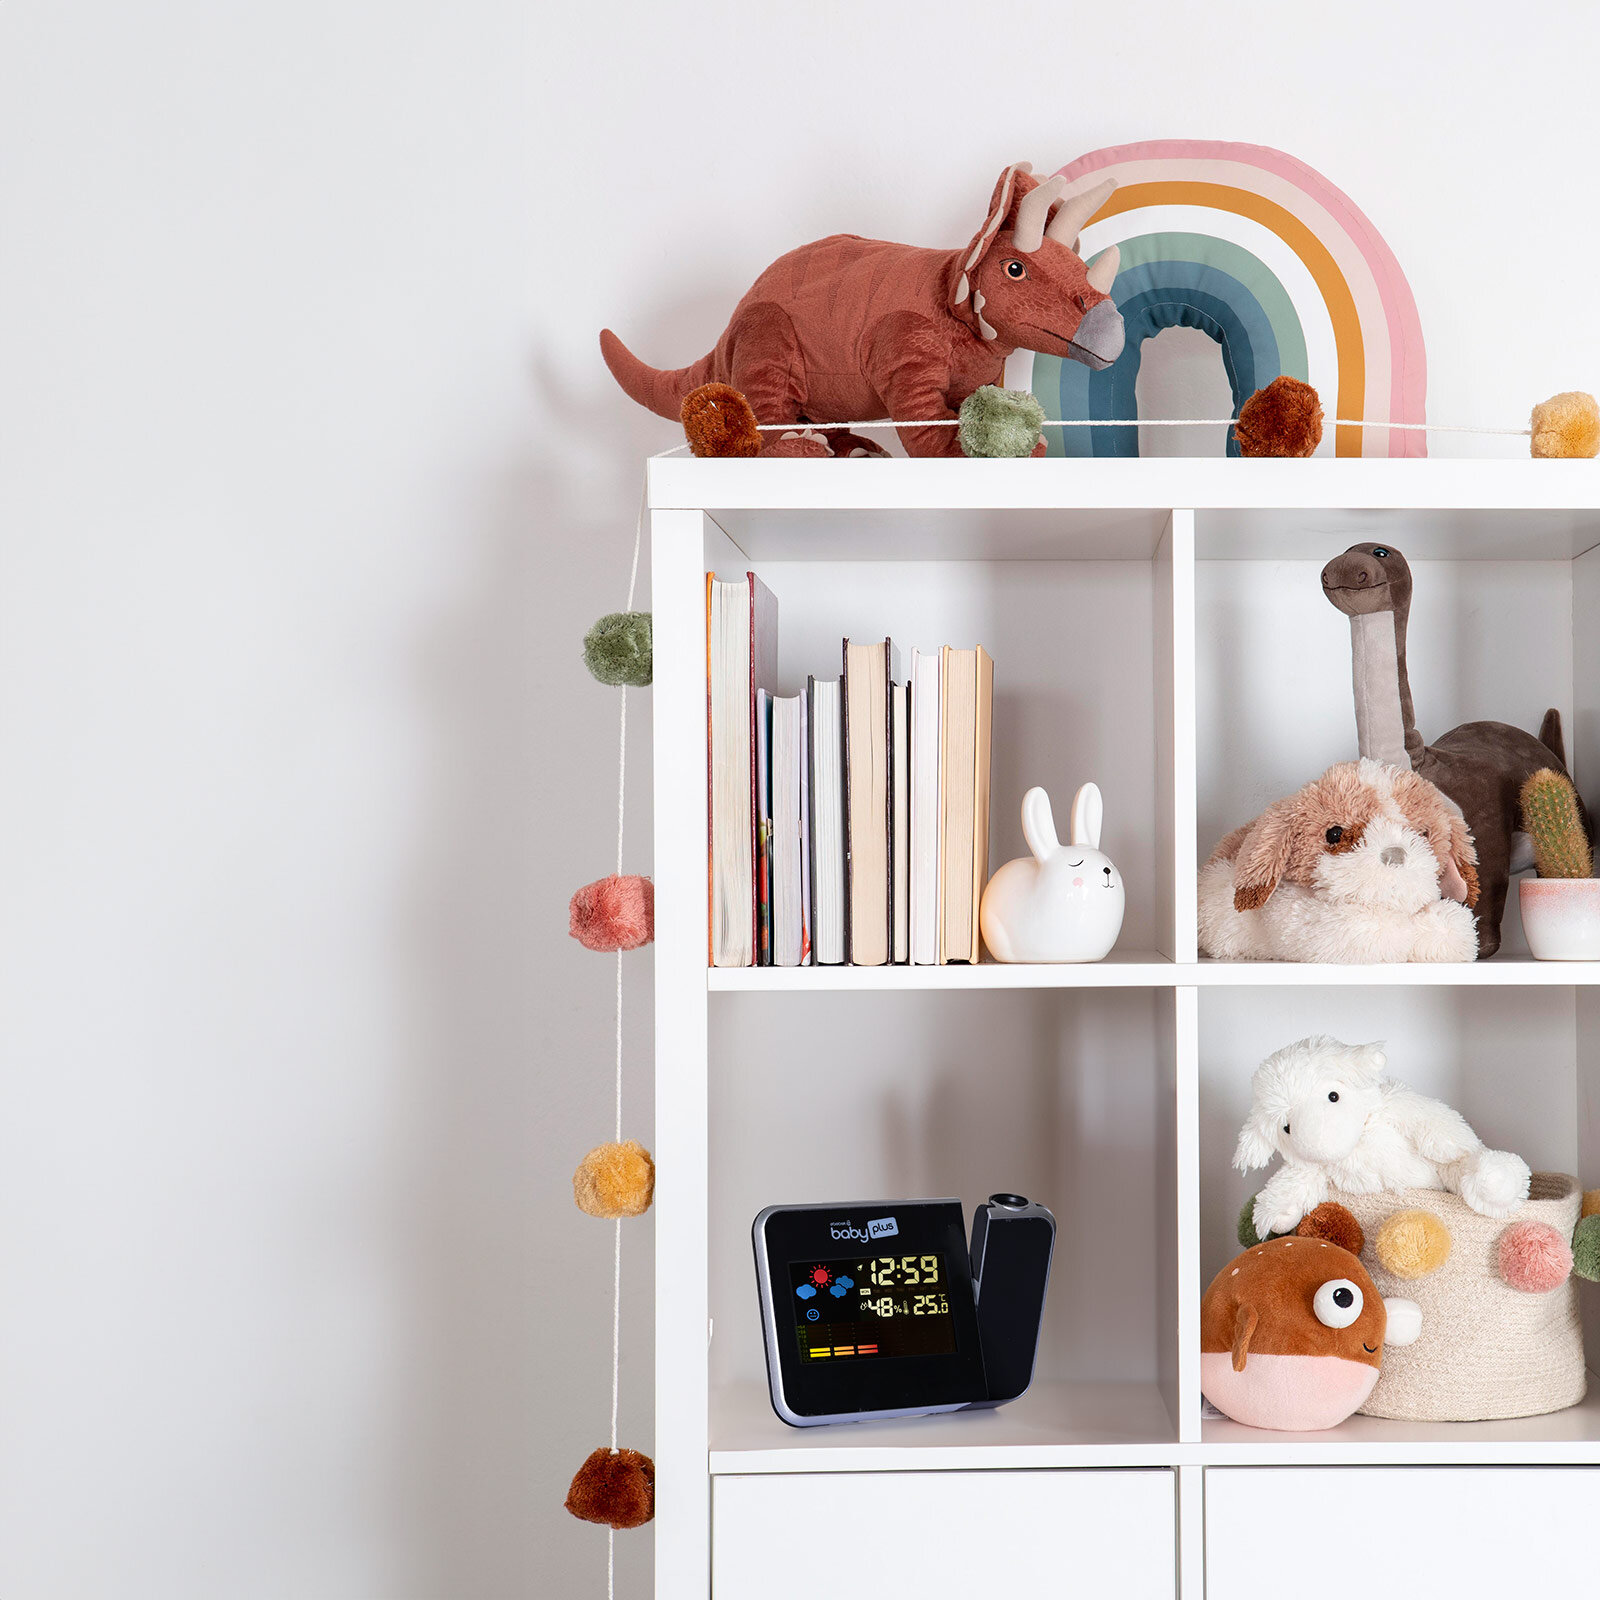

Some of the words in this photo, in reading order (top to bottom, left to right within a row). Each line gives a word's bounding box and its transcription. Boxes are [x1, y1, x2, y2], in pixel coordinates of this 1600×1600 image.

[830, 1226, 869, 1243] baby
[872, 1223, 894, 1235] plus
[870, 1255, 939, 1286] 12:59
